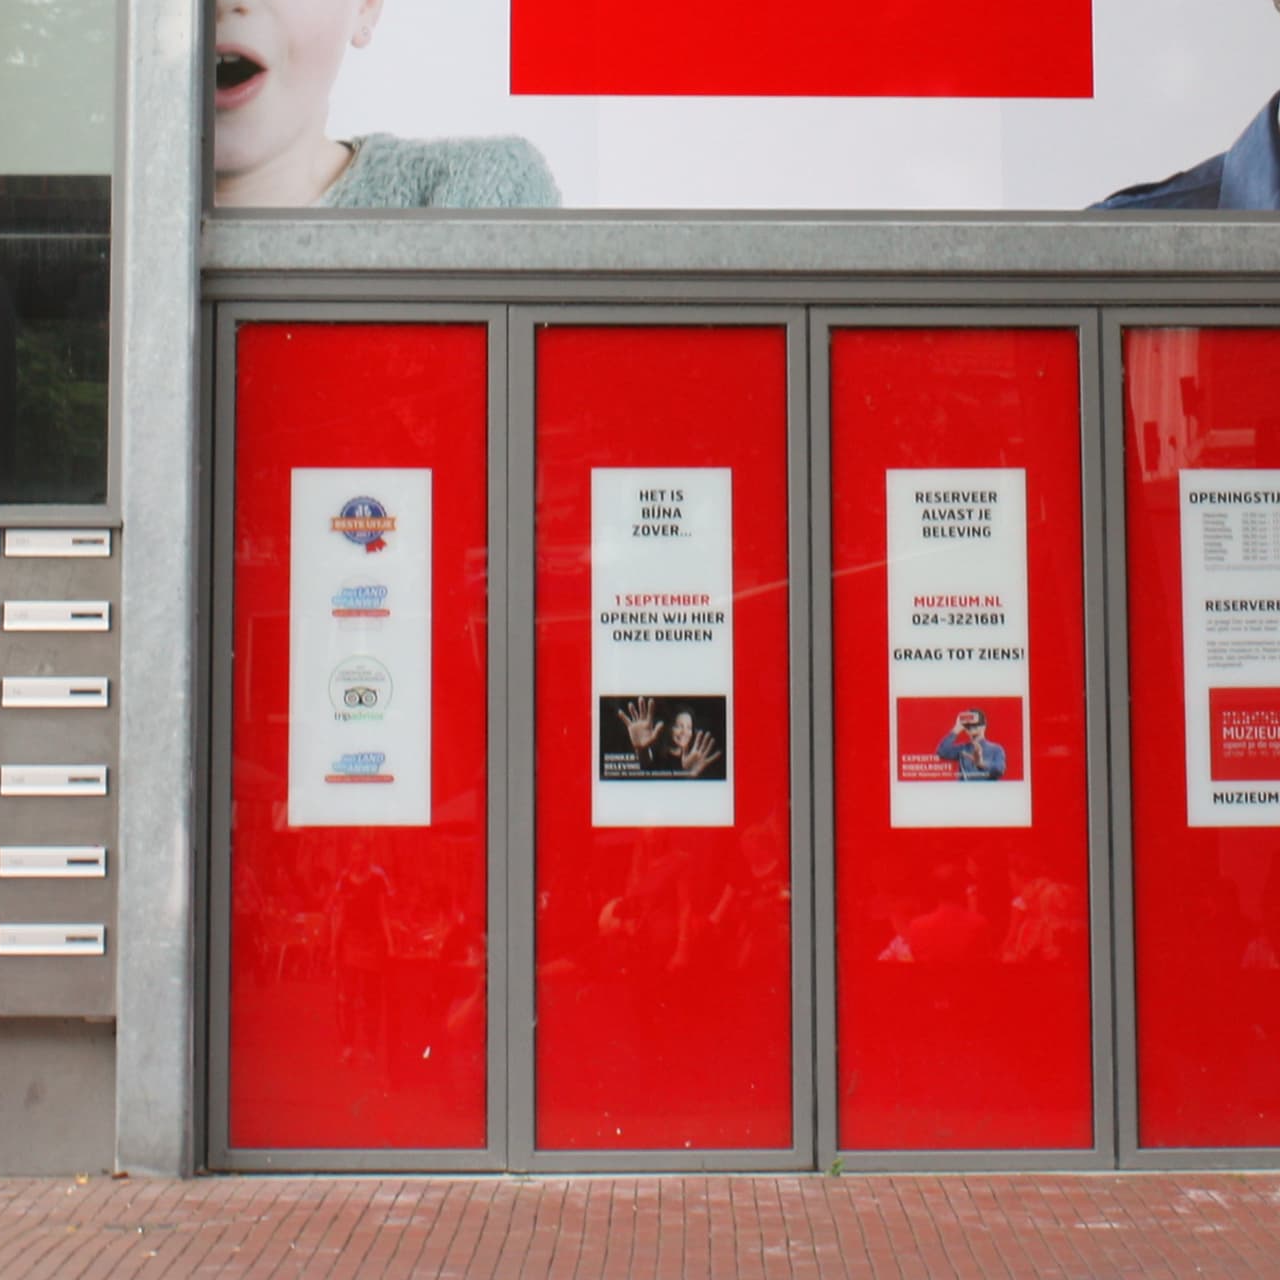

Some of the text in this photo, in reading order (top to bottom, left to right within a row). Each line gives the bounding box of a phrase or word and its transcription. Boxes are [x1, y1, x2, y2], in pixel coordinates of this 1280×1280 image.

[639, 489, 684, 502] HET IS
[915, 491, 998, 503] RESERVEER
[921, 508, 992, 521] ALVAST JE
[632, 524, 692, 537] ZOVER...
[922, 526, 992, 538] BELEVING
[615, 593, 710, 606] 1 SEPTEMBER
[913, 595, 1003, 608] MUZIEUM.NL
[600, 612, 725, 625] OPENEN WIJ HIER
[612, 629, 713, 642] ONZE DEUREN
[893, 648, 1024, 661] GRAAG TOT ZIENS!
